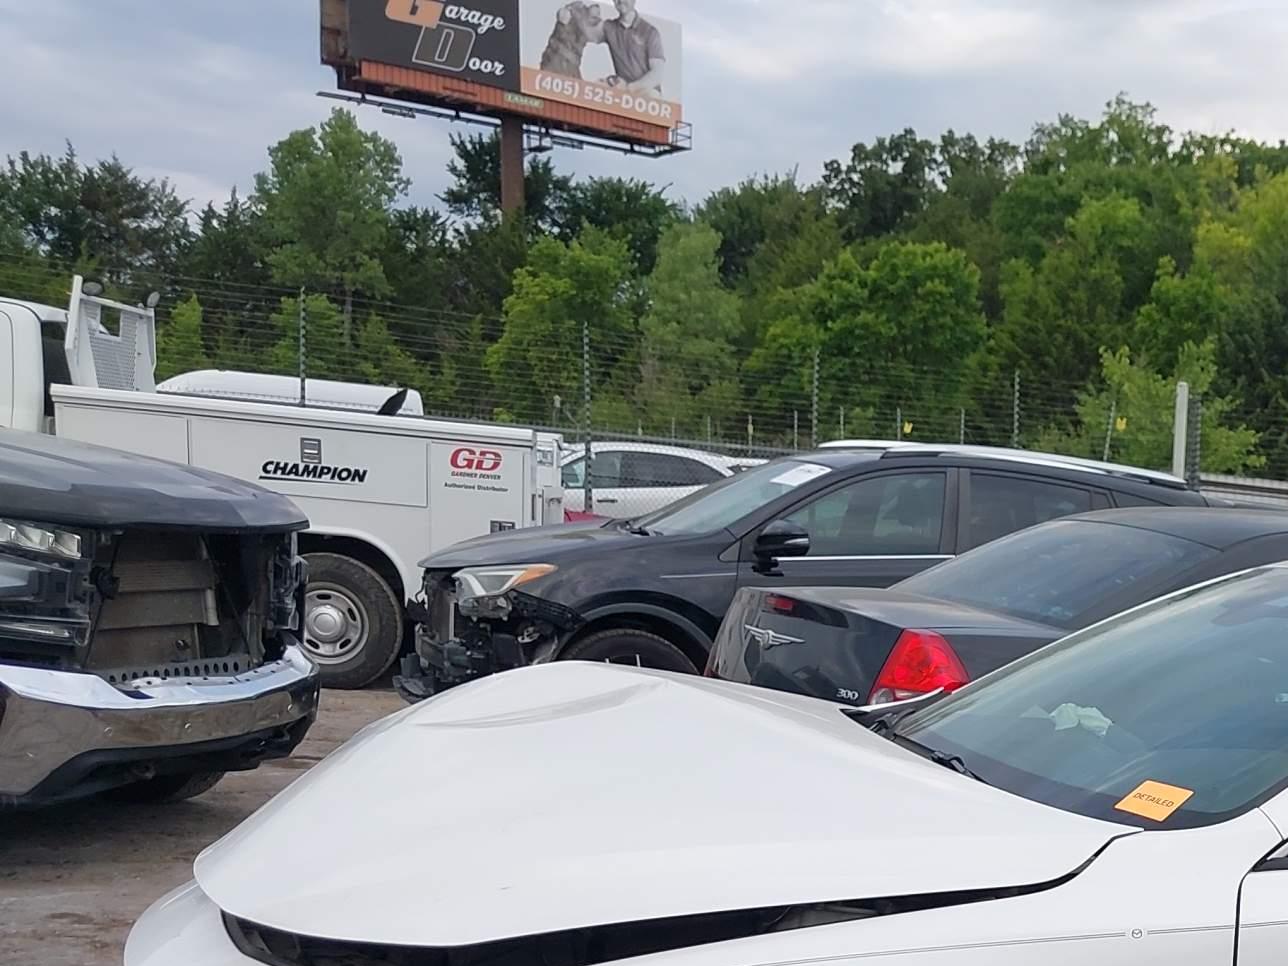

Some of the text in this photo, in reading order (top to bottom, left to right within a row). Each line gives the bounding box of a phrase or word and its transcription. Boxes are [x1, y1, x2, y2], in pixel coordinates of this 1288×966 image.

[535, 74, 672, 119] (405) 525-DOOR
[450, 447, 502, 471] GD
[261, 460, 368, 483] CHAMPION
[836, 688, 859, 700] 300
[1133, 792, 1174, 808] DETAILED
